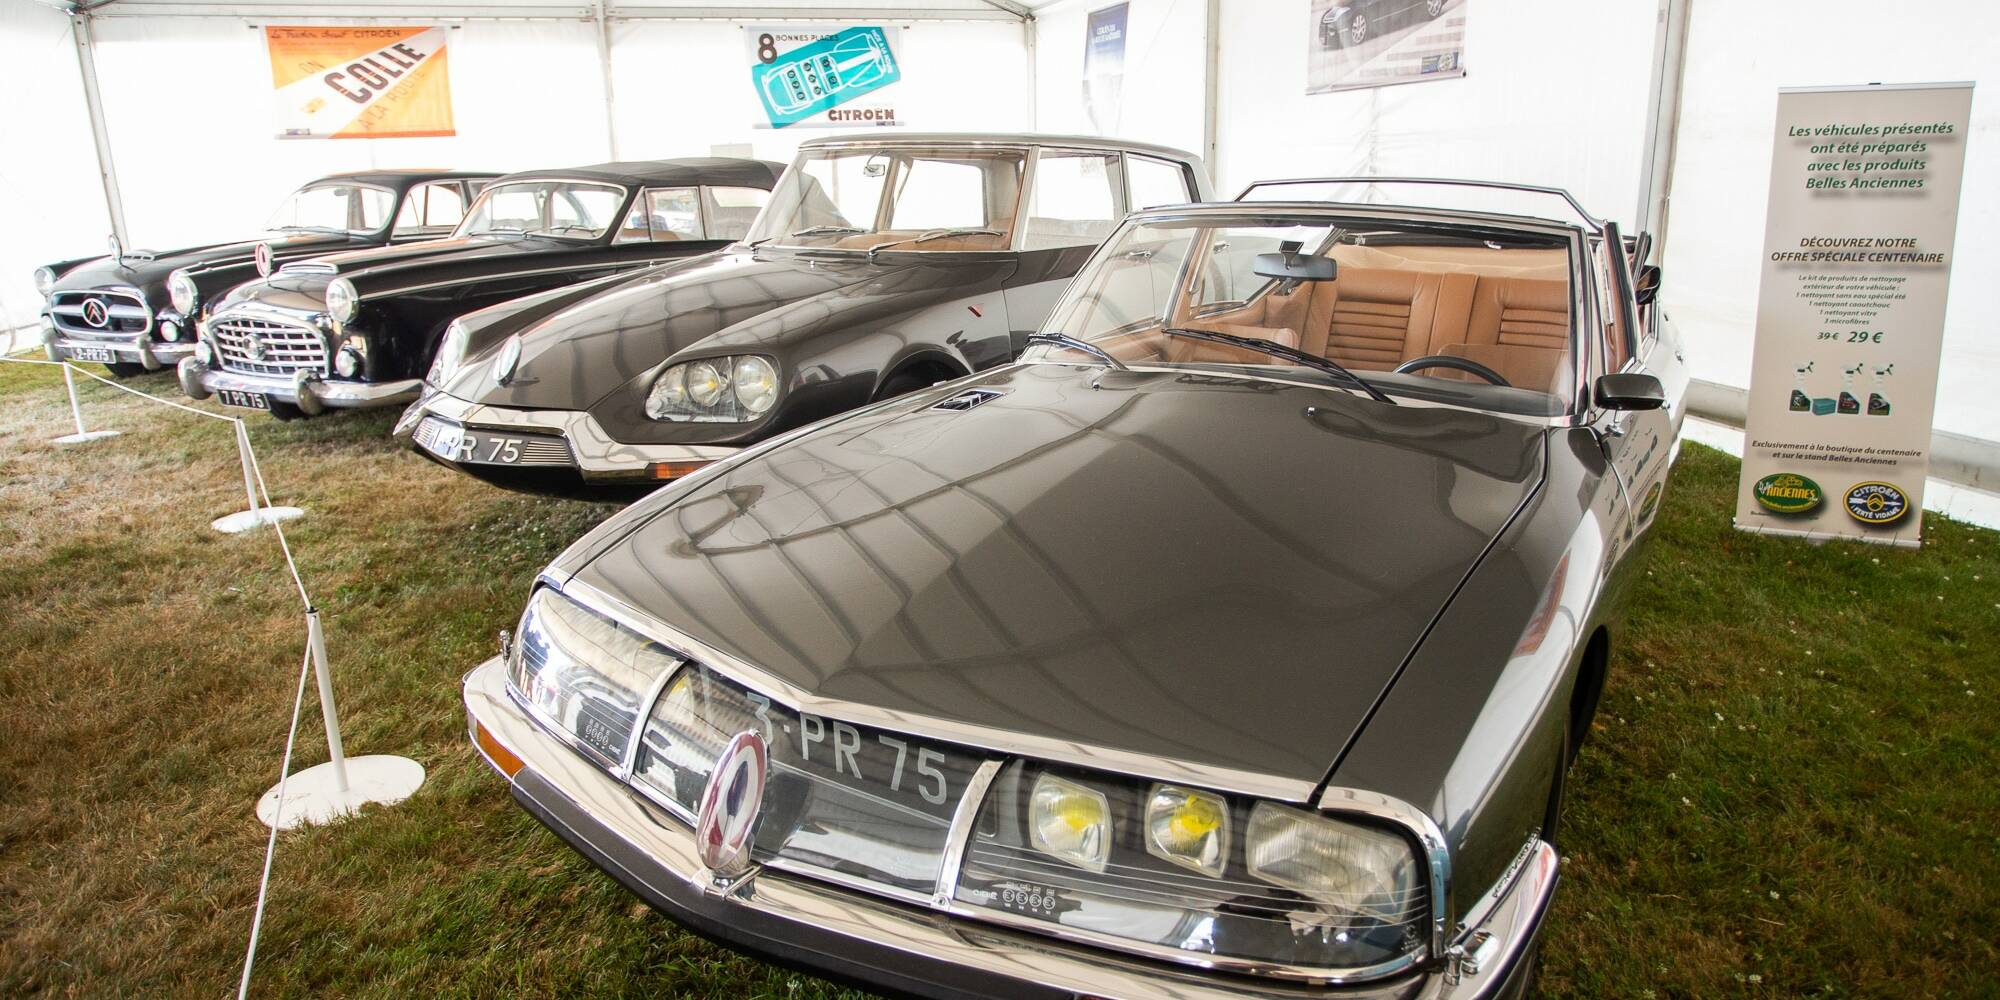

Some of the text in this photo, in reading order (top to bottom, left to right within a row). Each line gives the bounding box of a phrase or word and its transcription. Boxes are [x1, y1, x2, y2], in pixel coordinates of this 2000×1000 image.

[758, 33, 777, 65] 8
[775, 34, 808, 42] BONNES
[324, 43, 426, 104] COLLE
[1788, 121, 1954, 138] Les véhicules présentés
[1810, 140, 1927, 156] ont été préparés
[1807, 158, 1926, 174] avec les produits
[1806, 176, 1924, 189] Belles Anciennes
[1800, 236, 1918, 249] DÉCOUVREZ NOTRE
[1771, 250, 1945, 264] OFFRE SPÉCIALE CENTENAIRE
[1827, 275, 1858, 283] produits
[1869, 275, 1907, 284] nettoyage
[1866, 283, 1896, 291] véhicule
[1800, 292, 1835, 300] nettoyant
[1848, 301, 1891, 309] caoutchouc
[1824, 309, 1860, 317] nettoyant
[1829, 318, 1870, 326] microfibres
[1817, 331, 1831, 340] 39
[1847, 331, 1869, 343] 29
[1872, 331, 1883, 344] €
[220, 389, 230, 405] 7
[488, 437, 523, 463] 75
[1752, 440, 1922, 457] Exclusivement à la boutique du centenaire
[1772, 451, 1781, 459] et
[1796, 452, 1804, 460] le
[1804, 453, 1828, 462] stand
[1828, 454, 1853, 463] Belles
[1854, 456, 1897, 466] Anciennes
[878, 734, 948, 806] 75
